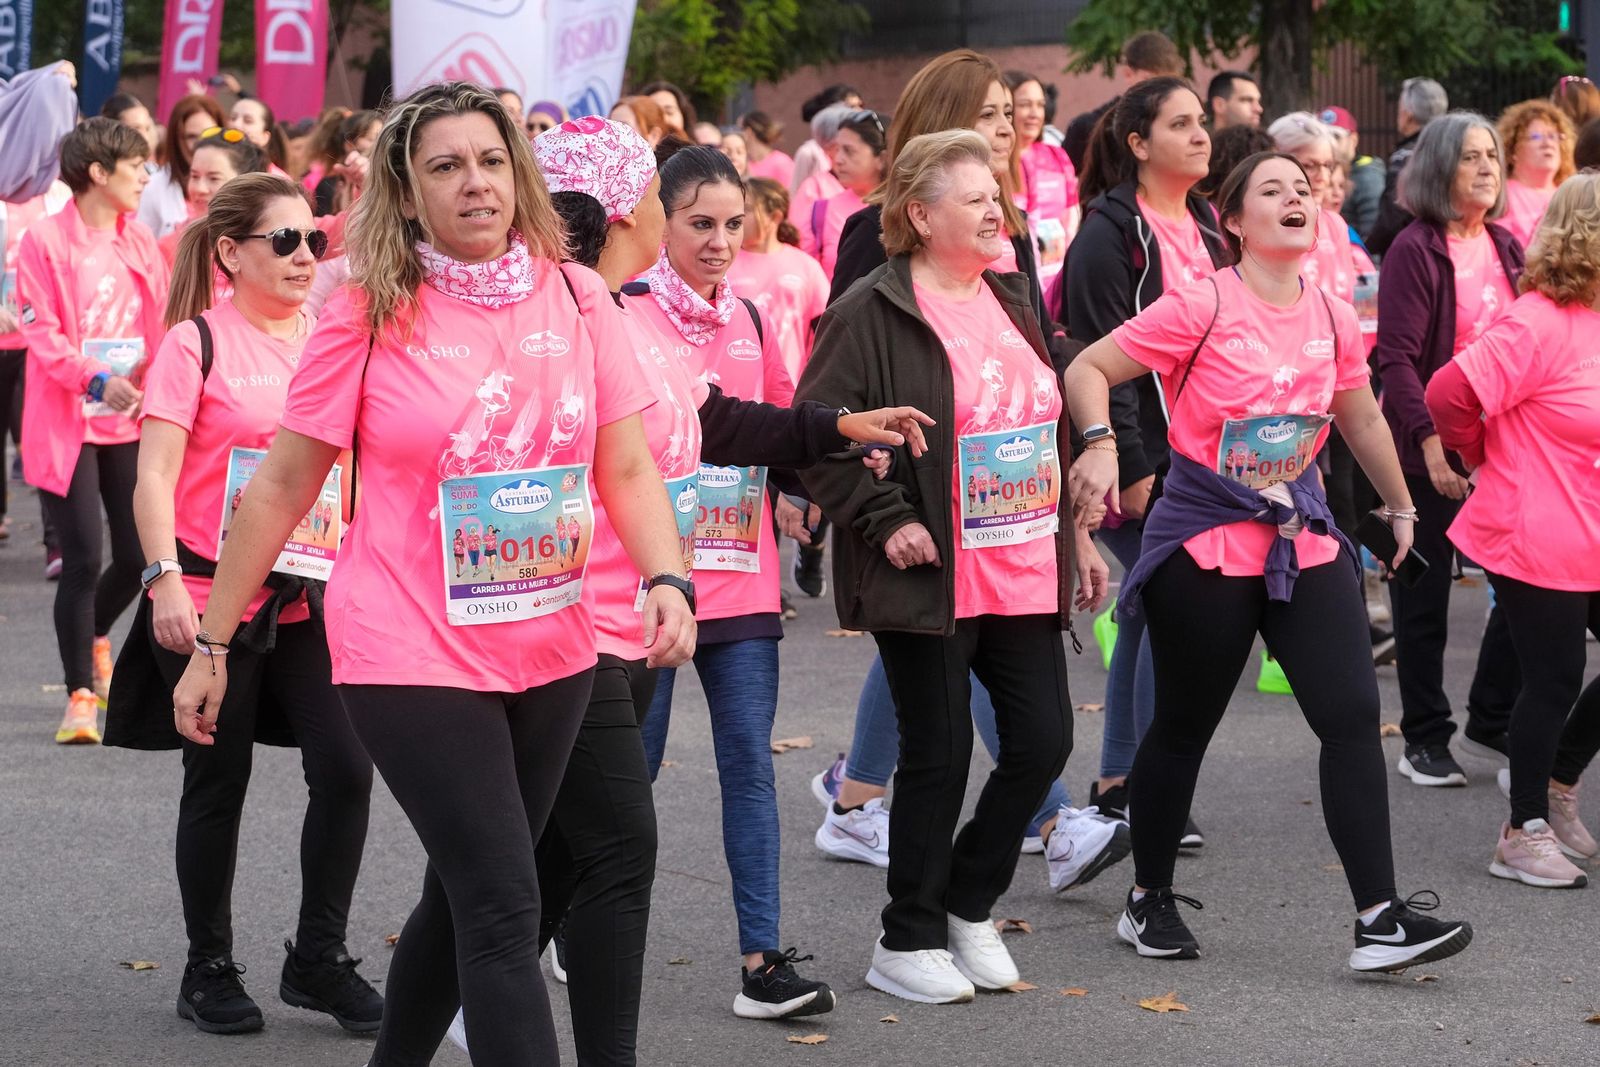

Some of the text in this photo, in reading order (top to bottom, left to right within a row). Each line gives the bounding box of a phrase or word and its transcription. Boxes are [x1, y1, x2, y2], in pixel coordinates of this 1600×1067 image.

[228, 374, 281, 387] OYSHO
[1258, 455, 1297, 477] 016
[451, 490, 479, 500] SUMA
[1001, 477, 1037, 500] 016
[495, 492, 550, 508] ASTURIANA
[1014, 502, 1027, 513] 574
[979, 517, 1005, 525] CARRERA
[1014, 513, 1021, 521] LA
[705, 529, 722, 538] 573
[976, 528, 1014, 541] OYSHO
[306, 547, 325, 556] SEVILLA
[500, 534, 555, 563] 016
[296, 560, 327, 573] Santander
[518, 567, 538, 579] 580
[471, 584, 505, 594] CARRERA
[507, 583, 516, 591] DE
[518, 581, 527, 590] LA
[529, 578, 548, 589] MUJER
[467, 590, 572, 616] OYSHO Santander
